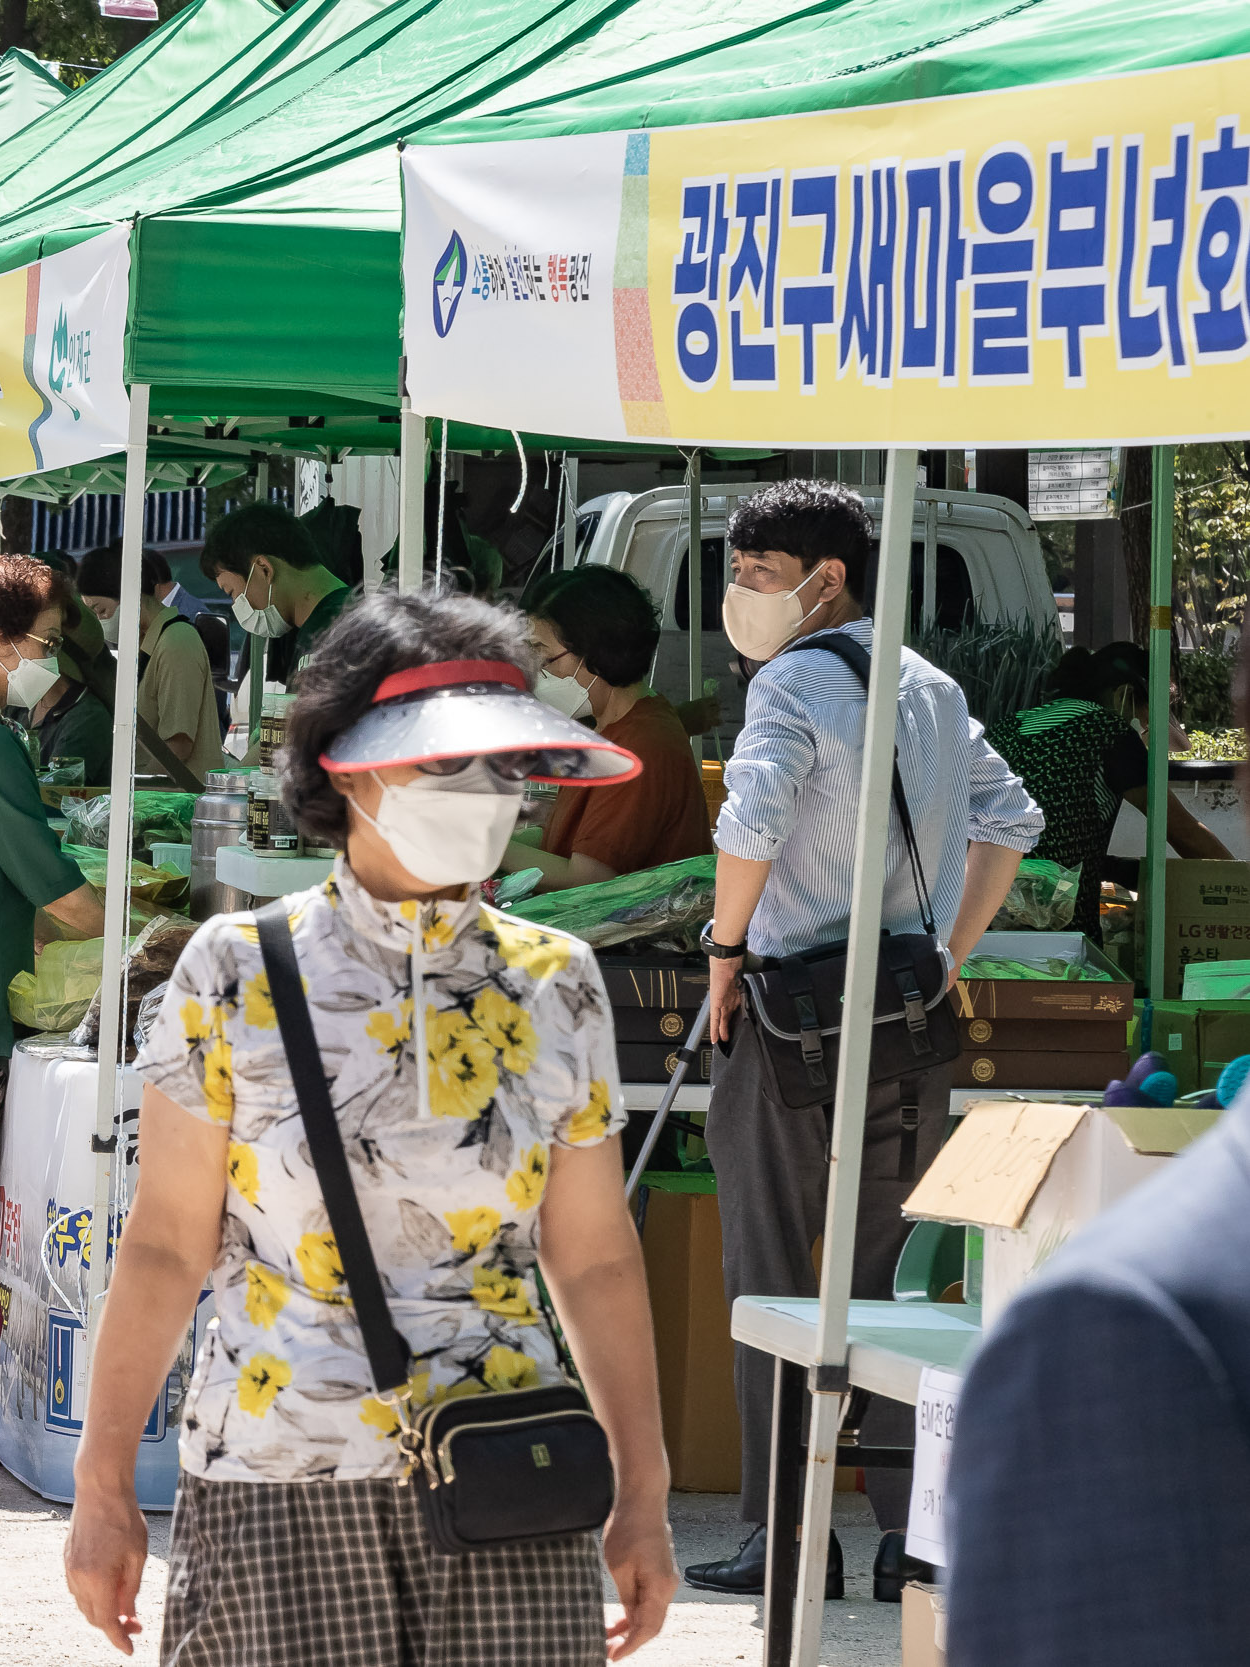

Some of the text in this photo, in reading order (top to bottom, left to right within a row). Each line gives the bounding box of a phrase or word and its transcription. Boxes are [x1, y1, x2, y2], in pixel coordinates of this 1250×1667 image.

[67, 330, 91, 388] 인제군
[1178, 924, 1201, 938] LG
[1178, 946, 1220, 965] 홈스타
